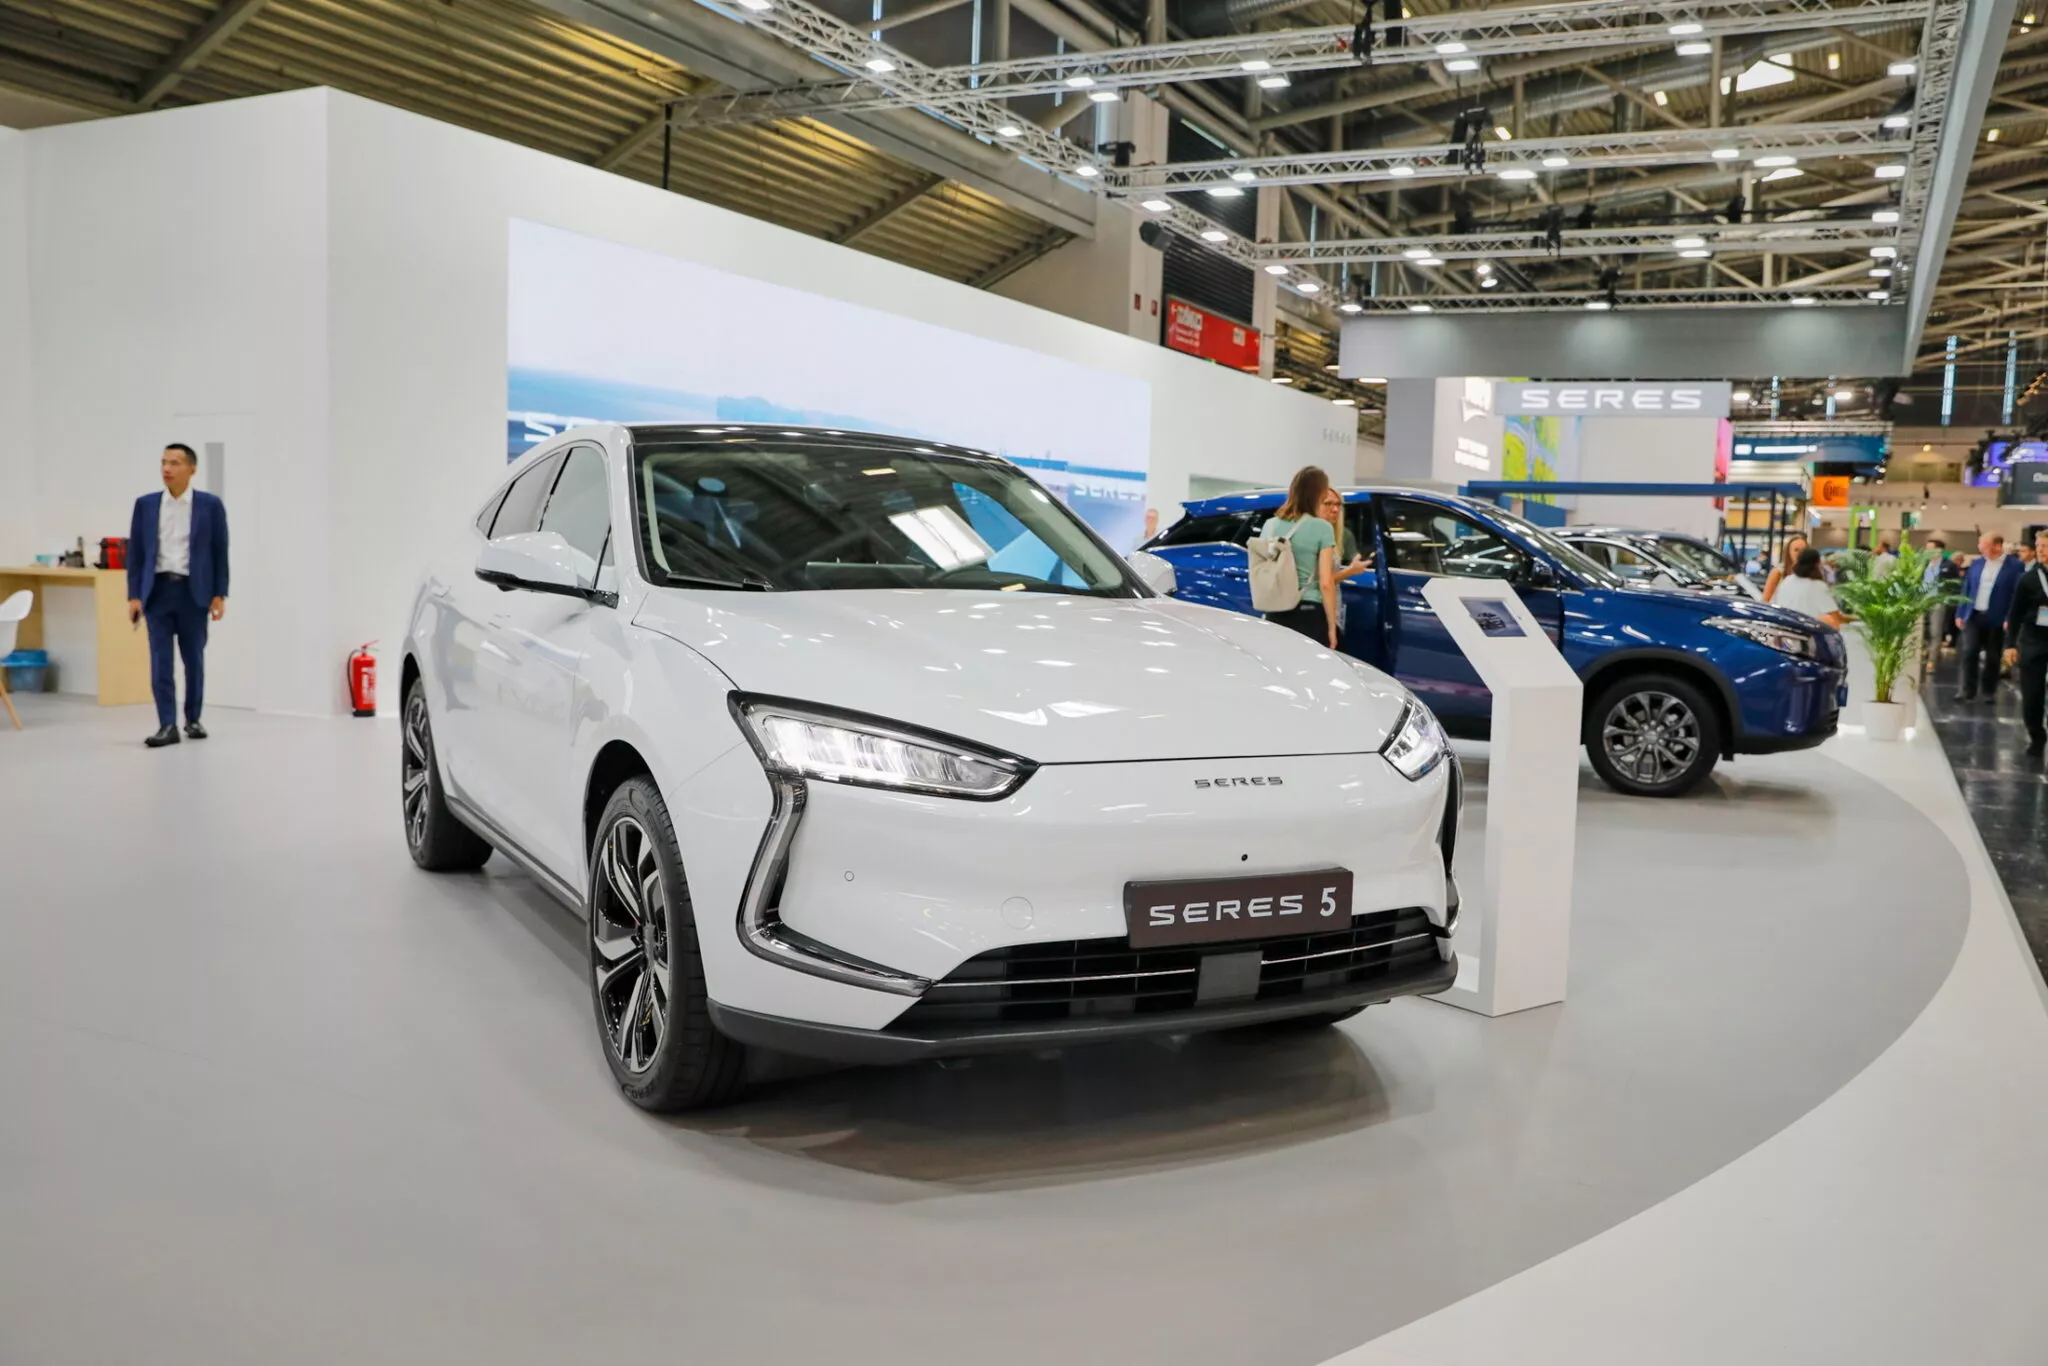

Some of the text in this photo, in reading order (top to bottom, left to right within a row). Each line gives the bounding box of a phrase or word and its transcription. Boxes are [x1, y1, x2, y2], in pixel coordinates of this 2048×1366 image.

[1521, 389, 1702, 409] SERES
[1194, 776, 1283, 789] SERES
[1149, 887, 1337, 926] SERES 5
